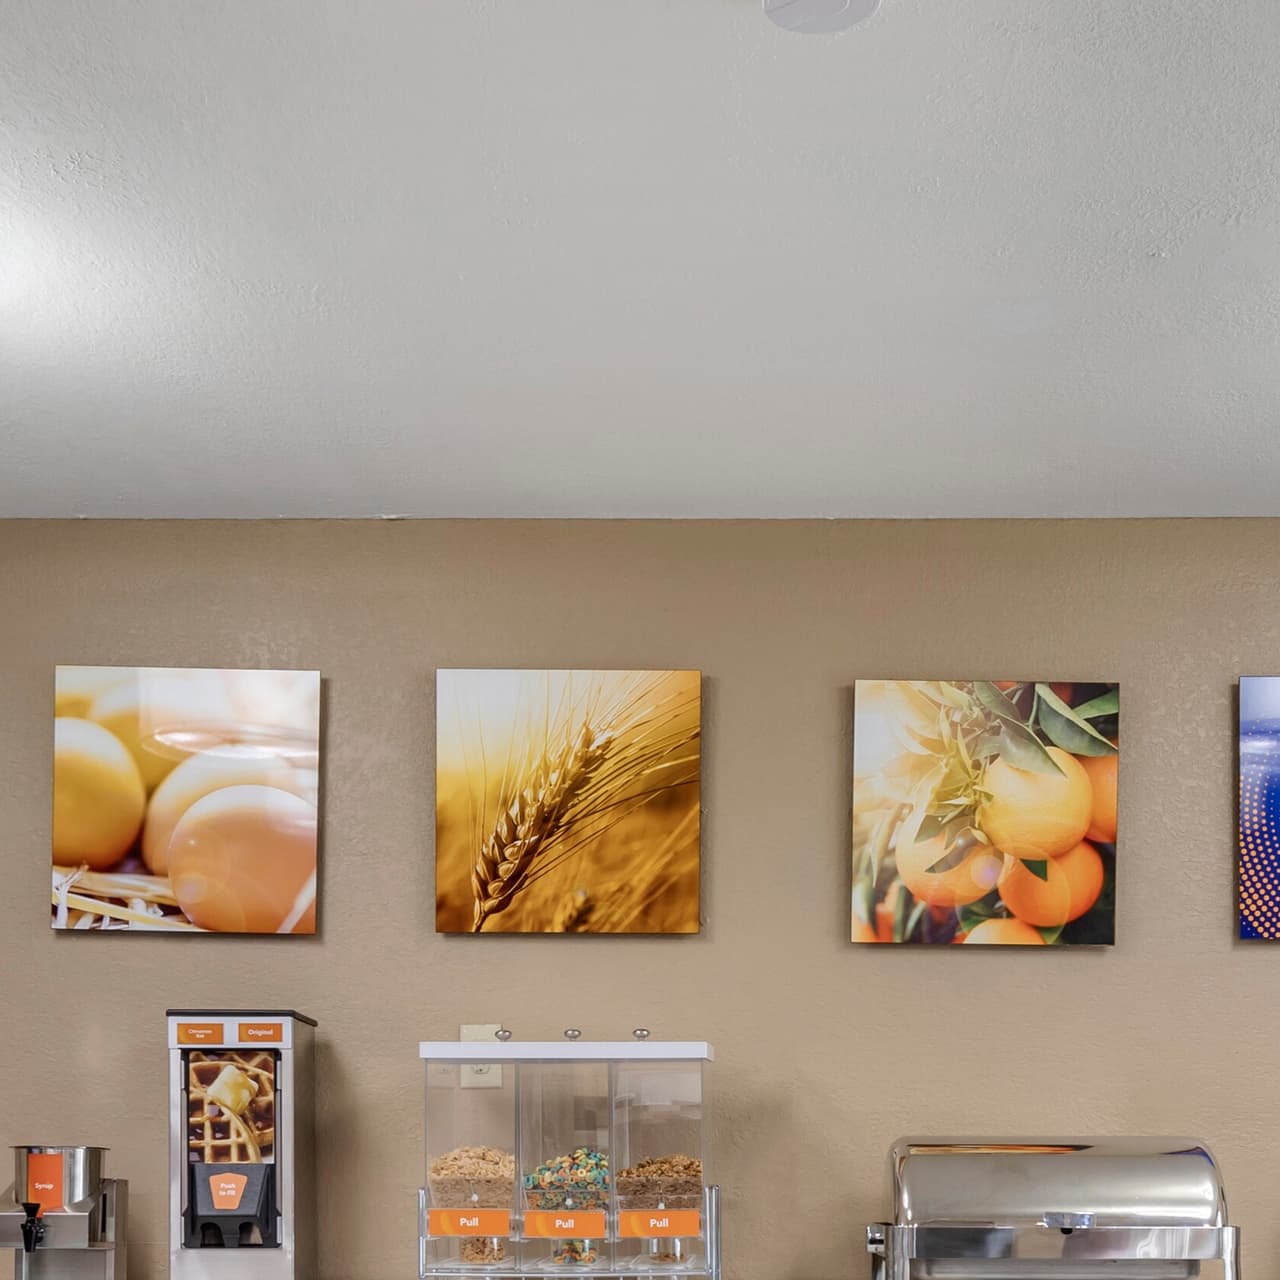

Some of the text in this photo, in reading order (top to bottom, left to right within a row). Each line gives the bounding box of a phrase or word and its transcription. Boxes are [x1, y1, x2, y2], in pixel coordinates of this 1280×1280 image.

[247, 1029, 274, 1037] Original
[34, 1182, 55, 1191] Syrup
[459, 1217, 480, 1227] Pull
[554, 1219, 576, 1229] Pull
[649, 1218, 670, 1228] Pull
